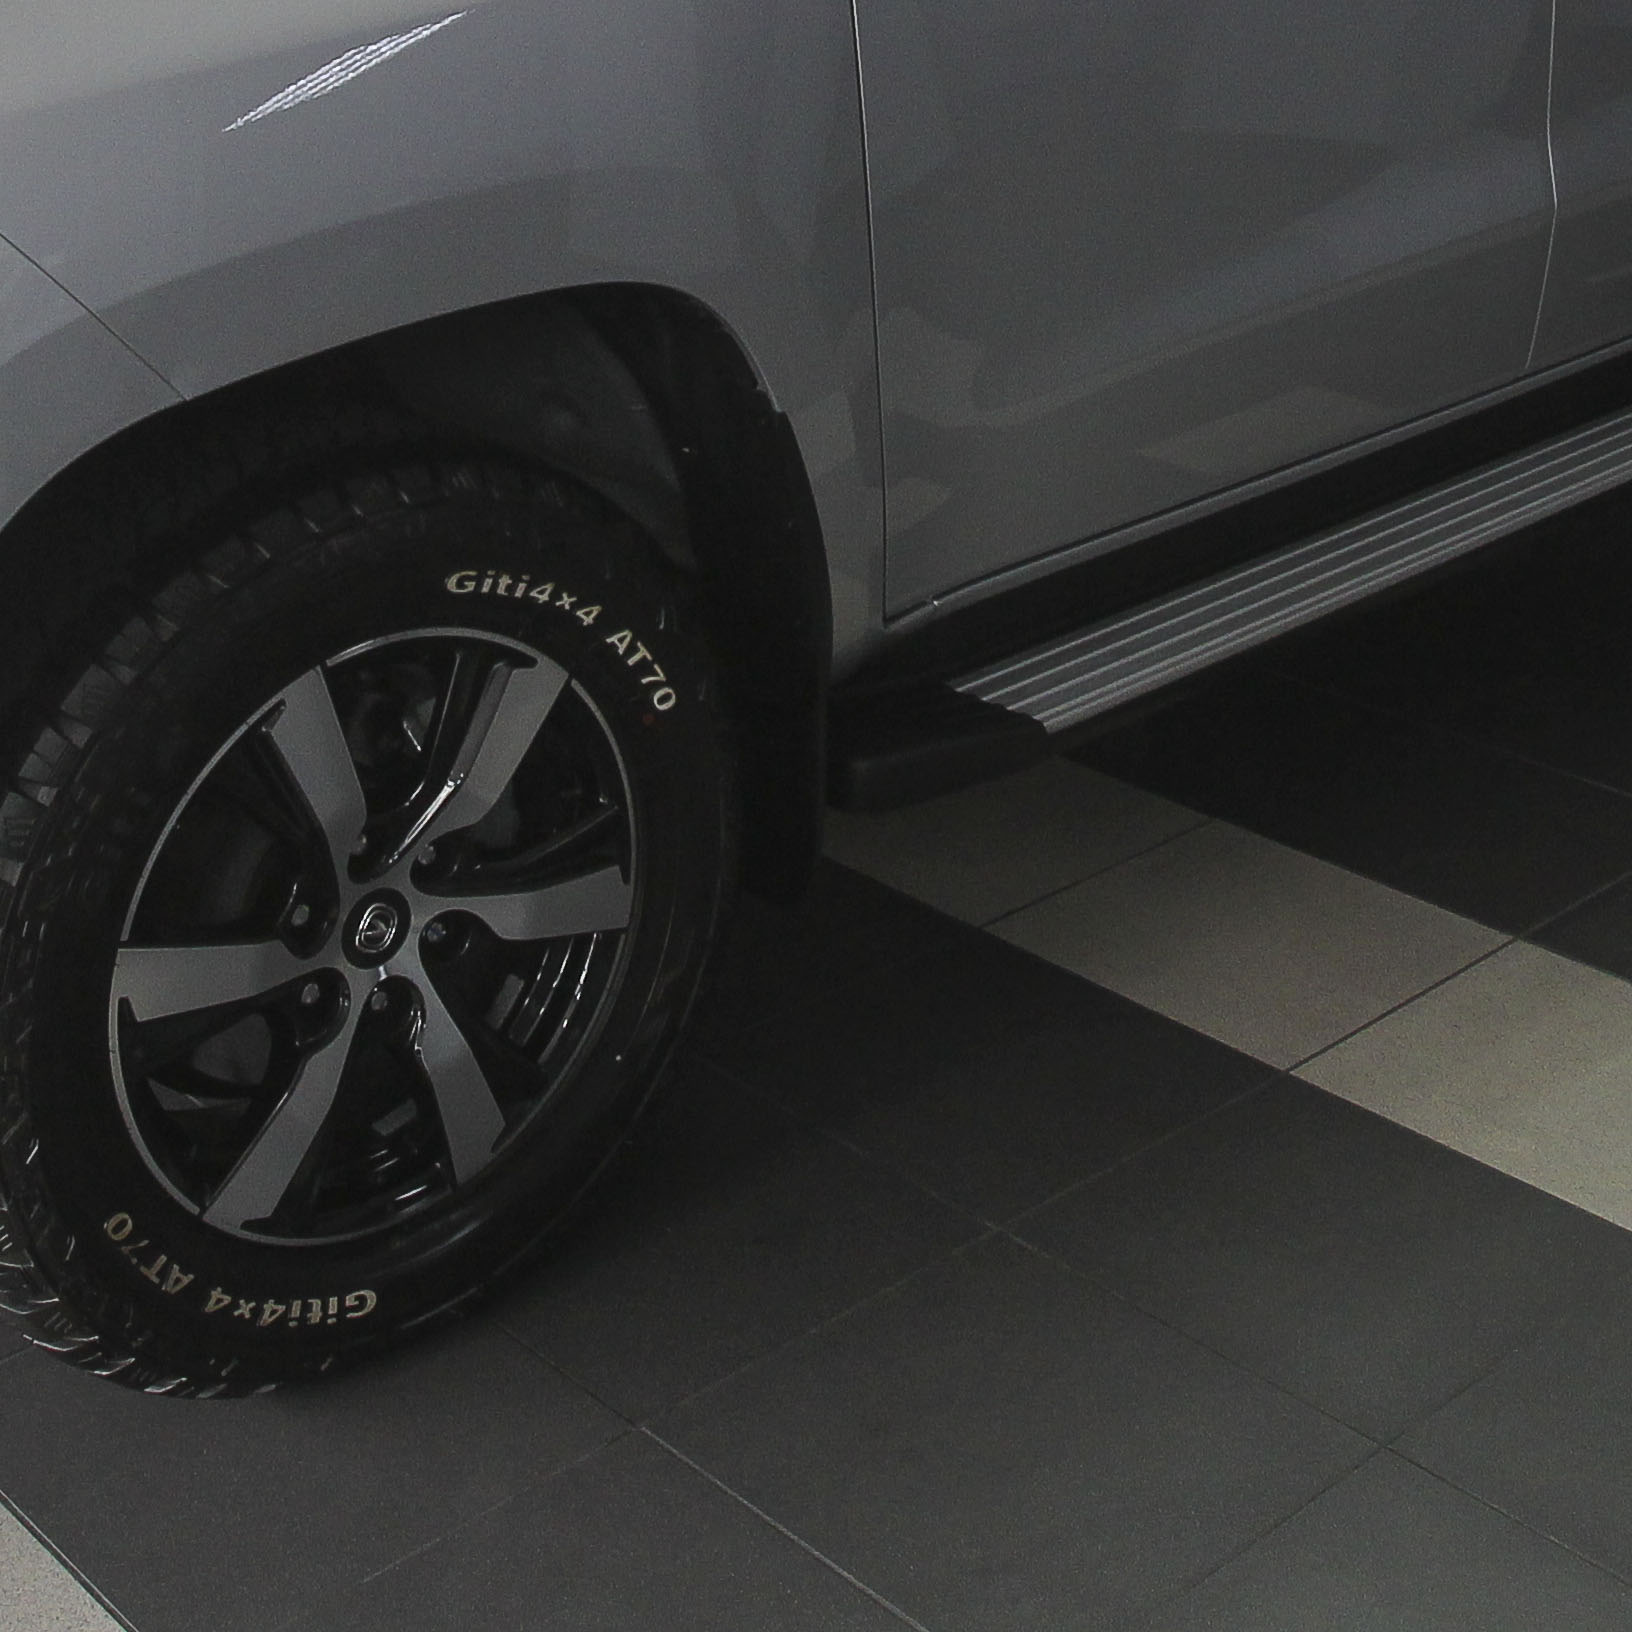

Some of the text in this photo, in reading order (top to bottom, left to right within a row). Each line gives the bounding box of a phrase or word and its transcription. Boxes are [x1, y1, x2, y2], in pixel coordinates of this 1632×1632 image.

[445, 570, 677, 711] Giti4x4 AT70
[104, 1212, 377, 1328] Giti4x4 AT70
